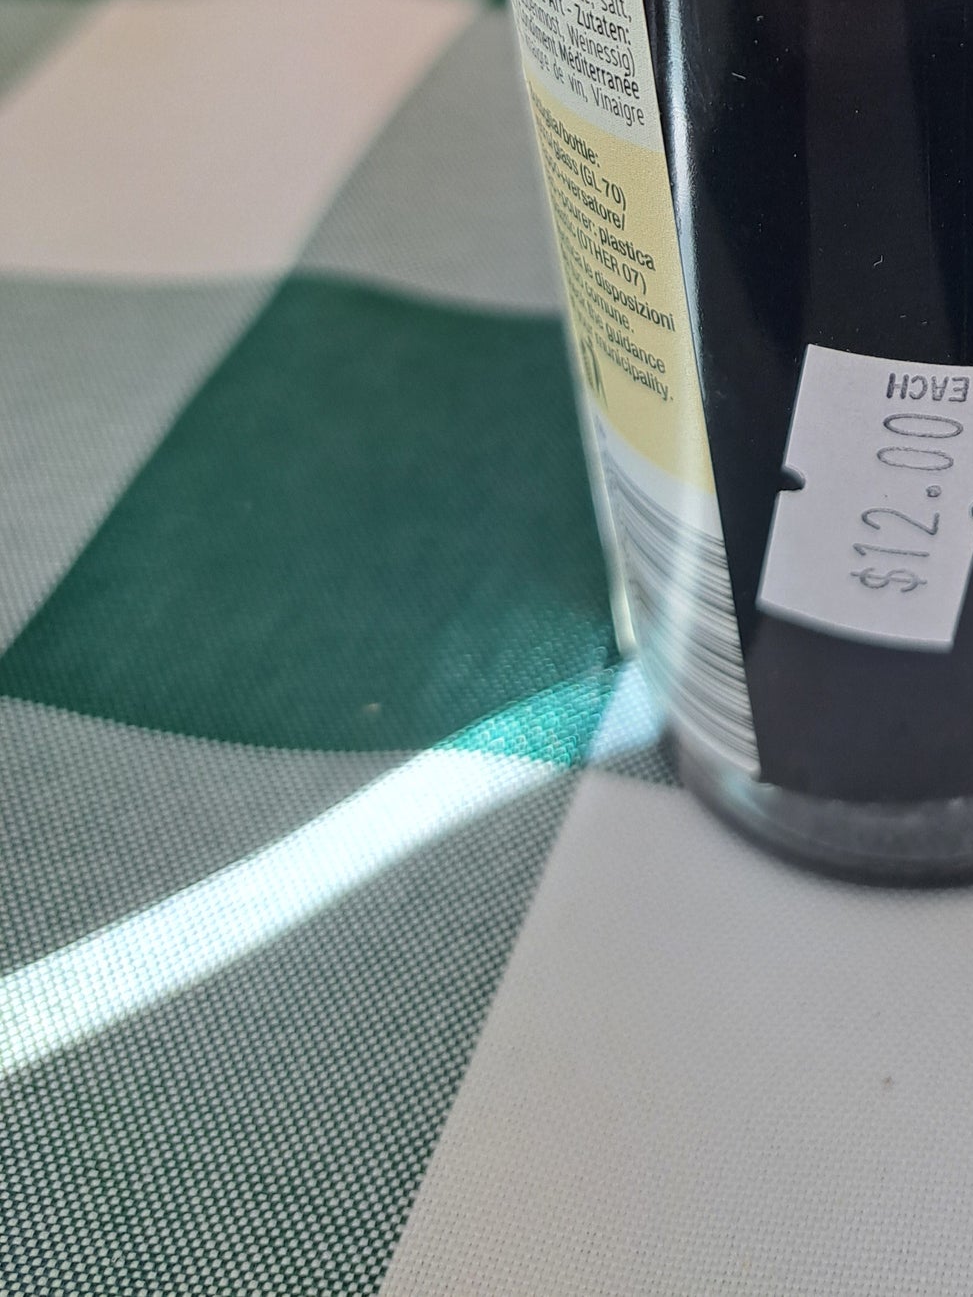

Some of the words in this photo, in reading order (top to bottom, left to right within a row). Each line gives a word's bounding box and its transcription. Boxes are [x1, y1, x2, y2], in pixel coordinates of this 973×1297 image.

[566, 22, 636, 78] Weinessig)
[574, 2, 632, 47] Zutaten:
[558, 40, 641, 101] Méditerranée
[568, 72, 588, 103] vin,
[590, 83, 646, 128] Vinaigre
[580, 161, 602, 194] (GL
[602, 176, 627, 212] 70)
[576, 228, 621, 276] (OTHER
[622, 264, 647, 296] 07)
[598, 225, 656, 272] plastica
[584, 280, 635, 335] comune.
[594, 269, 676, 333] disposizioni
[594, 330, 674, 402] municipality.
[605, 322, 667, 375] guidance
[886, 372, 970, 403] EACH
[850, 412, 964, 593] $12.00
